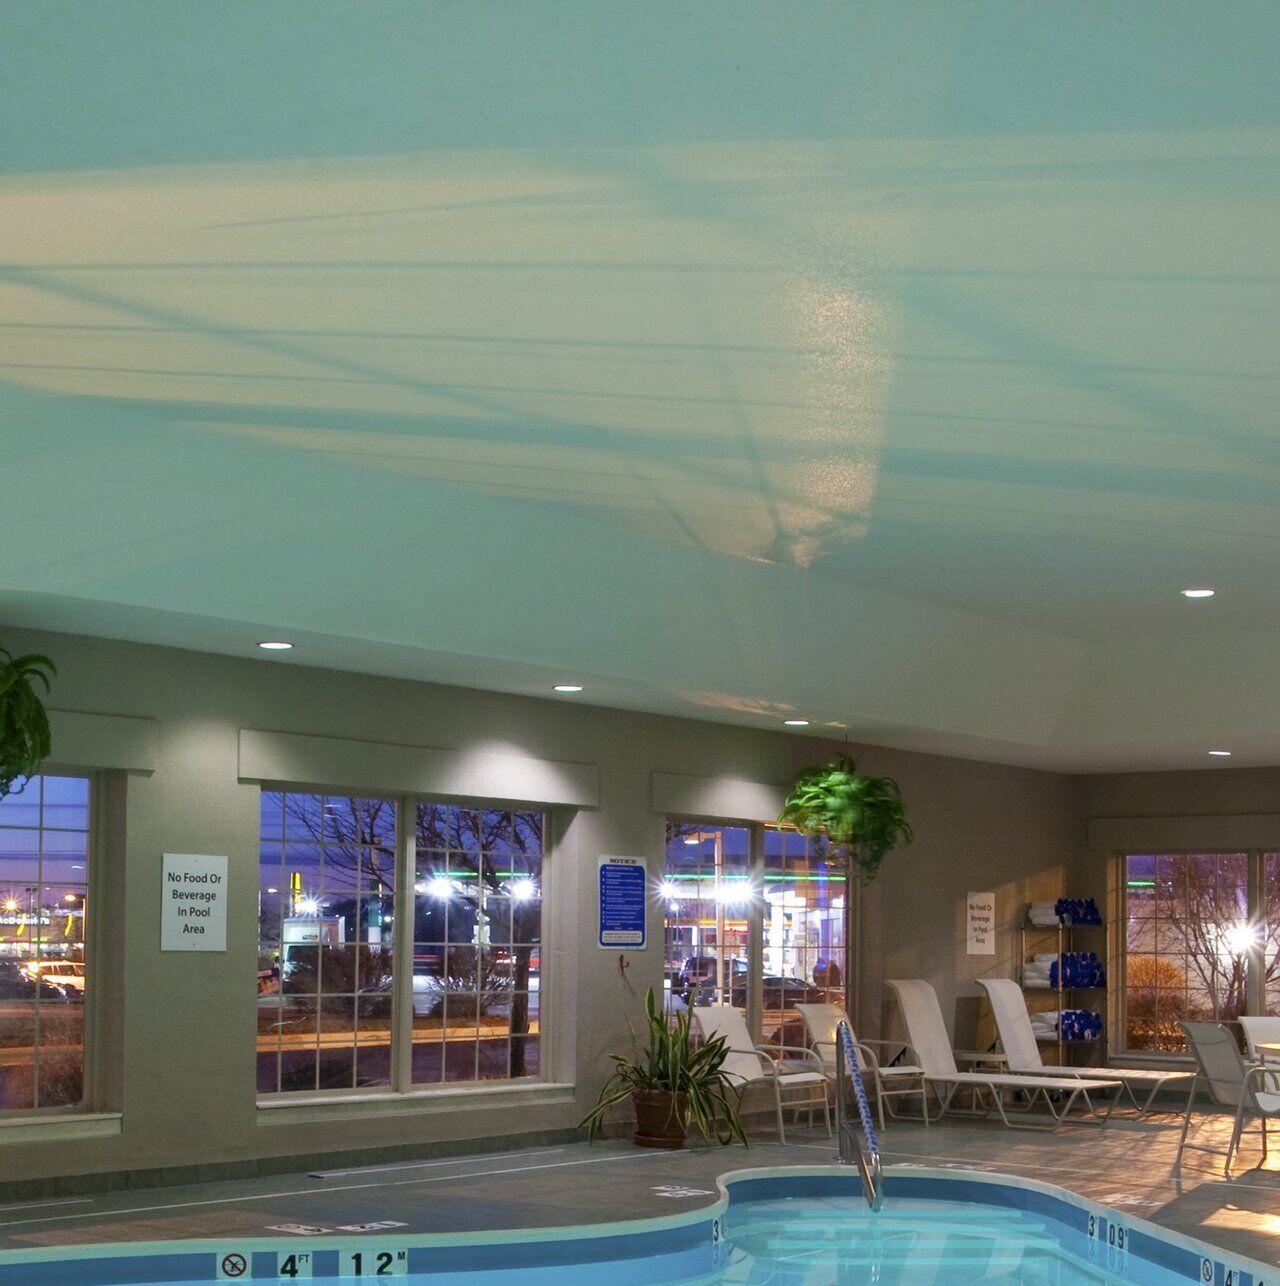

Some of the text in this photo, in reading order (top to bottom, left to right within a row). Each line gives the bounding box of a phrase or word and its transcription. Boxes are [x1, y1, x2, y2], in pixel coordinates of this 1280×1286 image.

[168, 872, 222, 884] No Food Or
[172, 889, 216, 903] Beverage
[177, 907, 210, 917] In Pool
[183, 924, 205, 934] Area
[397, 1251, 405, 1260] M
[280, 1254, 310, 1278] 4 FT
